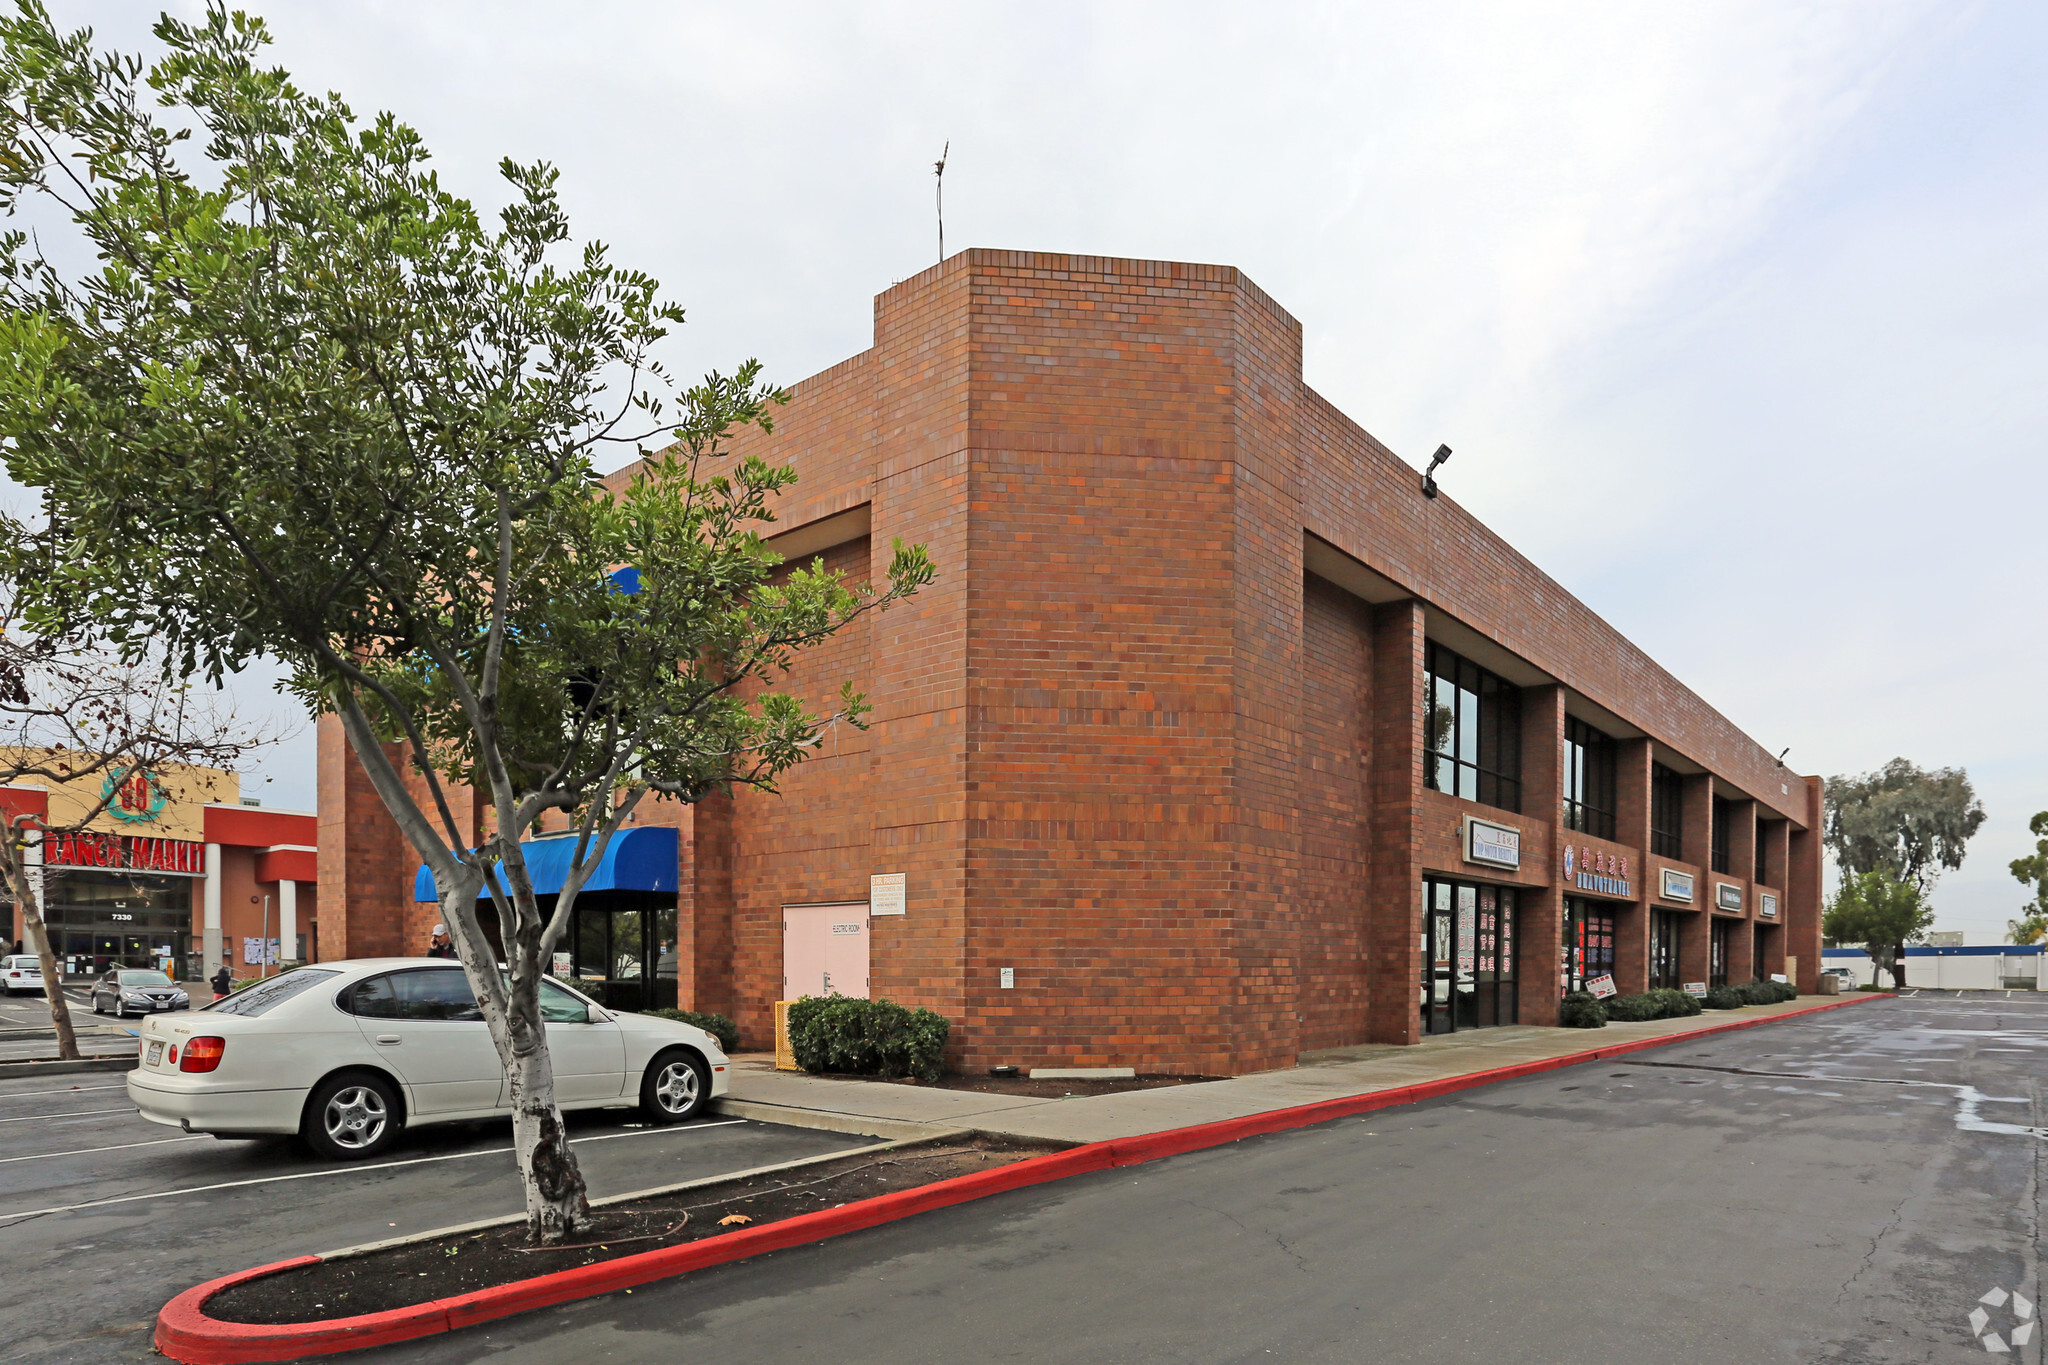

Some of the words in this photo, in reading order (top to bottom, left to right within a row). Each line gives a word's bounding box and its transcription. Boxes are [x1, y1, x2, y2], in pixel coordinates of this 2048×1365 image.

[45, 831, 122, 868] RANCH
[131, 837, 206, 873] MARKET
[1475, 841, 1484, 856] TOP
[1498, 847, 1512, 862] REALTY
[884, 876, 904, 884] PARKING
[111, 913, 133, 921] 7330
[832, 924, 848, 932] ELECTRIC
[848, 924, 860, 932] ROOM
